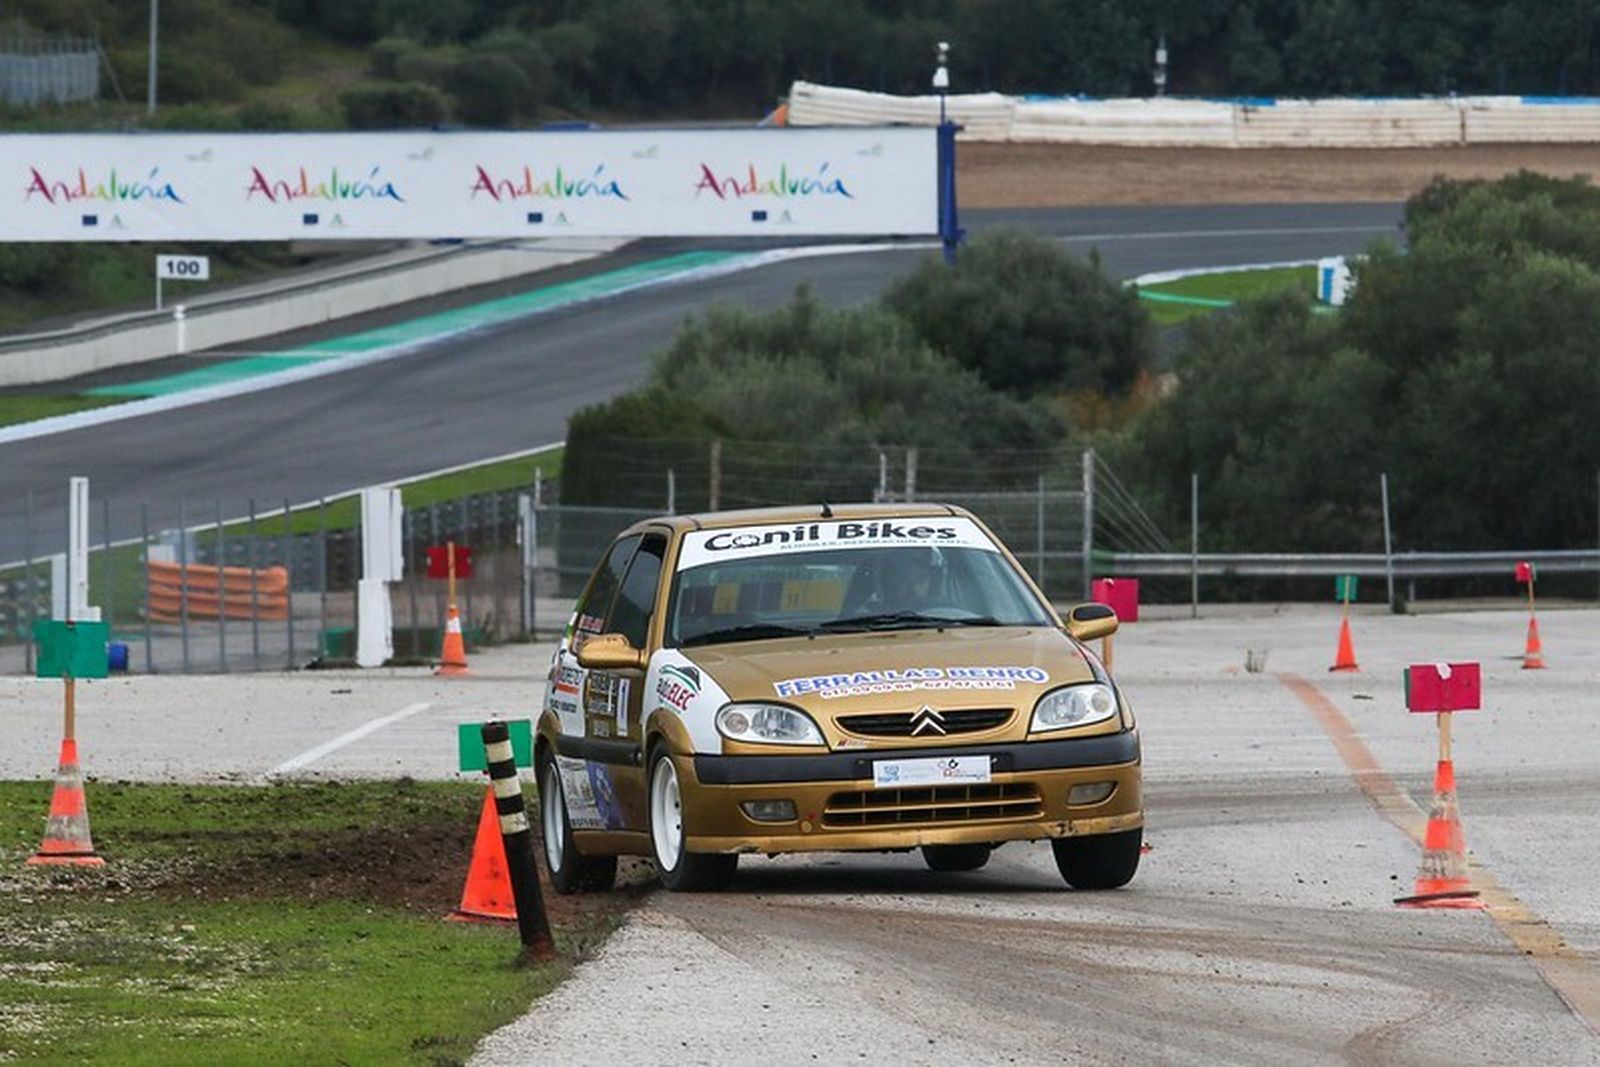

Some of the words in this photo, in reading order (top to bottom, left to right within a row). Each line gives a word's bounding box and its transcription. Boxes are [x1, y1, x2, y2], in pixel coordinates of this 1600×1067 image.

[24, 164, 185, 205] Andalucía
[246, 164, 406, 204] Andalucía
[469, 163, 630, 203] Andalucía
[694, 161, 855, 200] Andalucía
[165, 259, 200, 276] 100
[704, 524, 820, 551] Conil
[836, 522, 957, 541] Bikes
[777, 669, 940, 696] FERRALLAS
[948, 667, 1046, 682] BENRO
